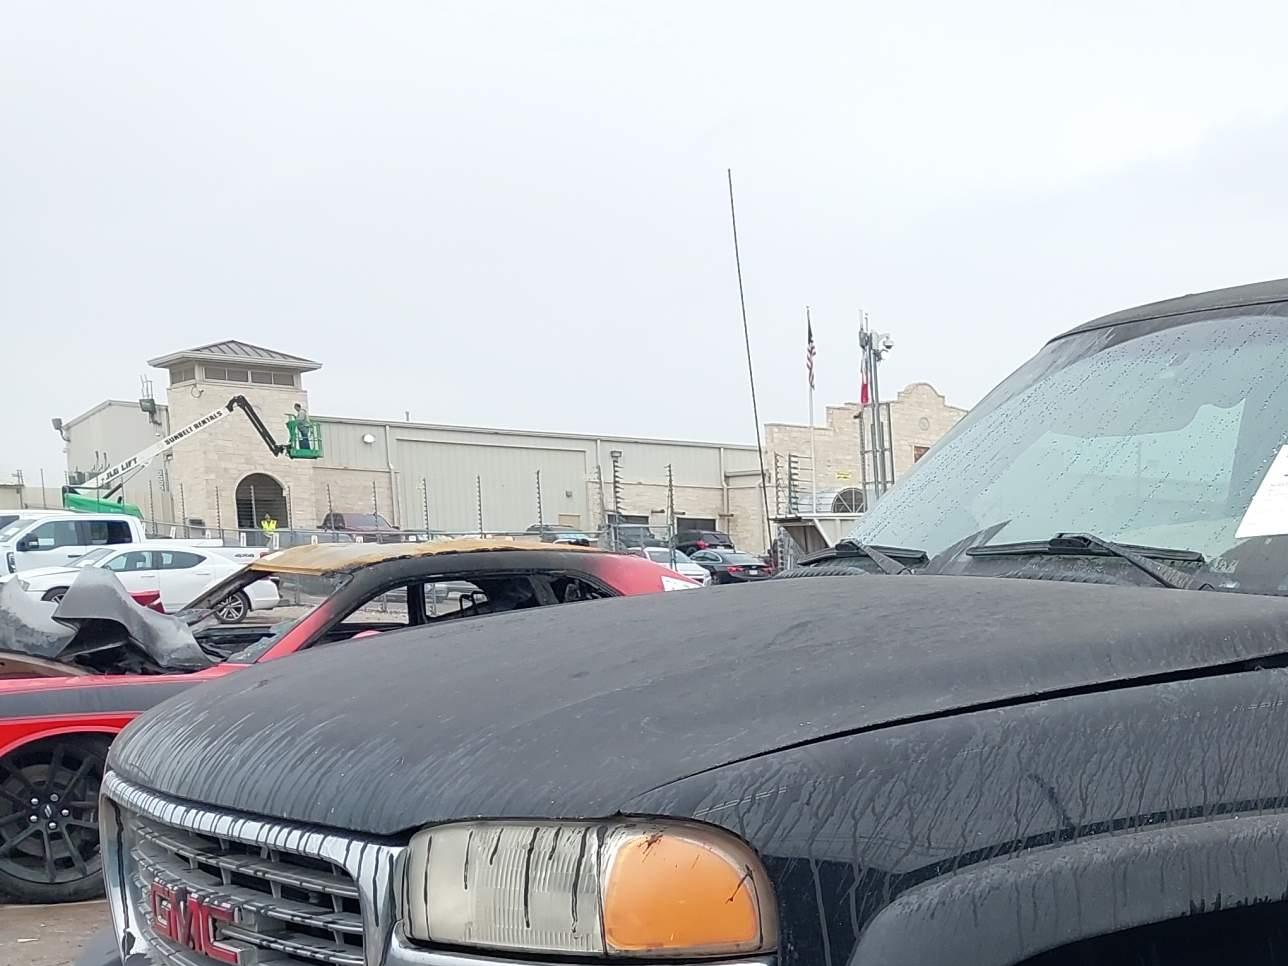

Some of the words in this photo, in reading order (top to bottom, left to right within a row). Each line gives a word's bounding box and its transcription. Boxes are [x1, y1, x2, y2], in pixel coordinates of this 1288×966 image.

[164, 426, 194, 446] SUNBELT
[194, 410, 223, 430] RENTALS
[105, 468, 119, 481] JLG
[121, 457, 138, 472] LIFT
[150, 876, 248, 966] GMC
